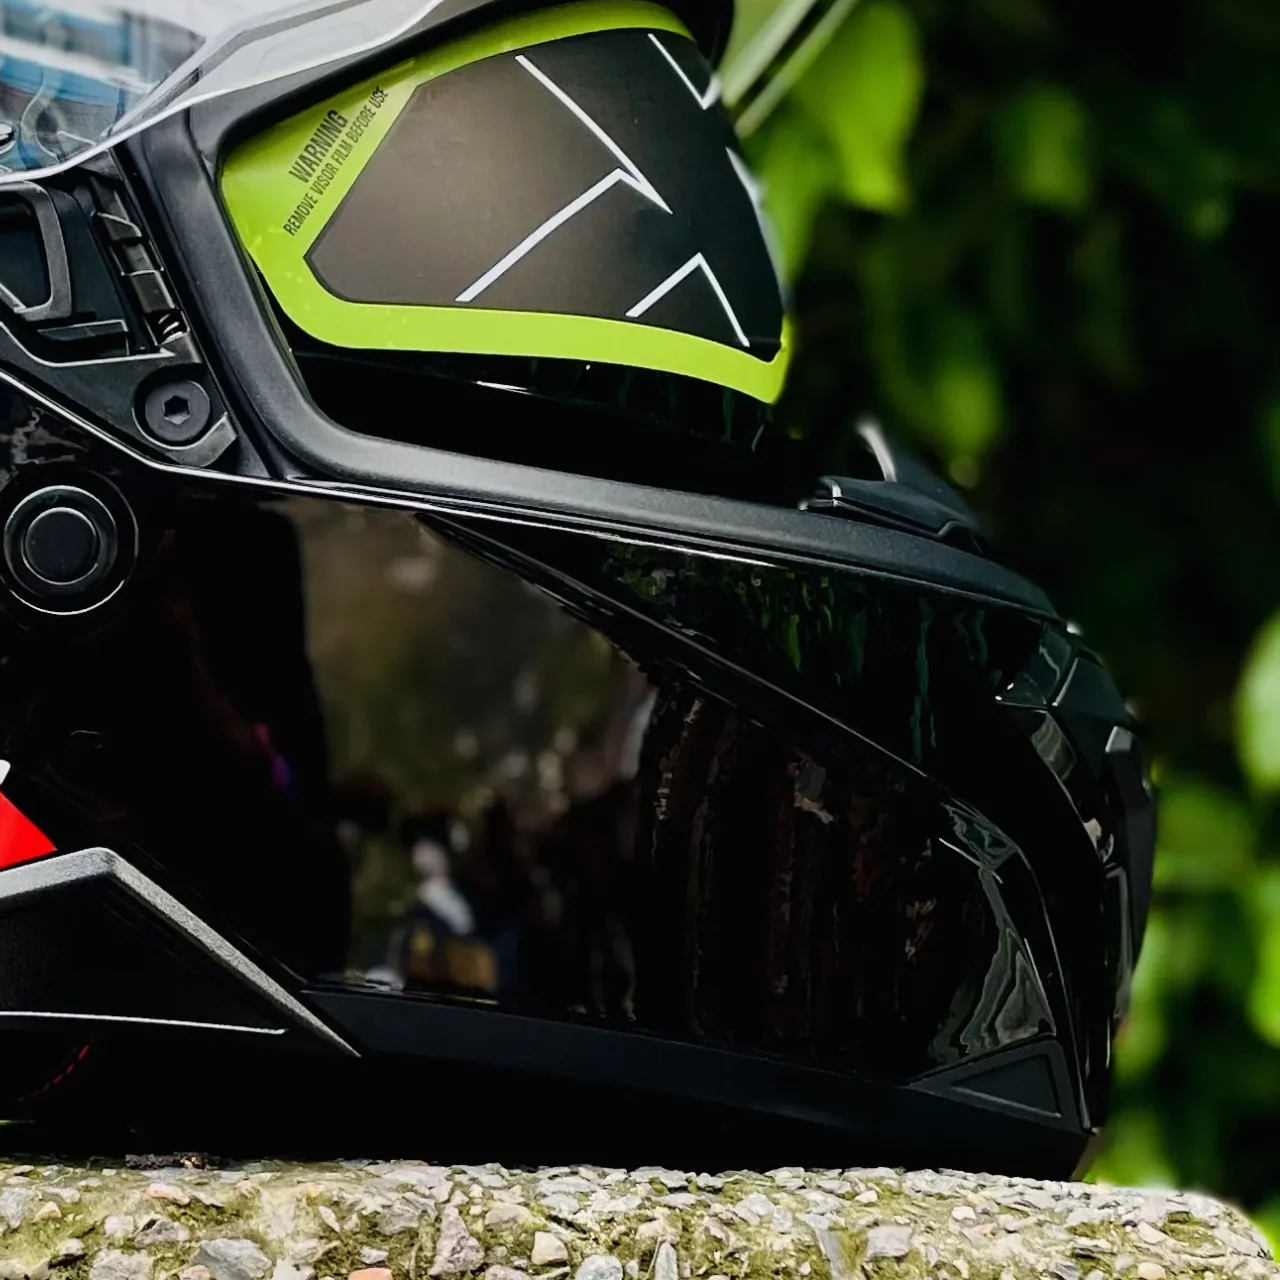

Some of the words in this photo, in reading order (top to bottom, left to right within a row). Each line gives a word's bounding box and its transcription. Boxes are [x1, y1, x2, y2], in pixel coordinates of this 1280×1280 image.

[283, 193, 318, 237] REMOVE
[310, 162, 340, 196] VISOR
[331, 140, 354, 166] FILM
[346, 104, 376, 144] BEFORE
[370, 85, 389, 109] USE
[288, 108, 348, 184] WARNING
